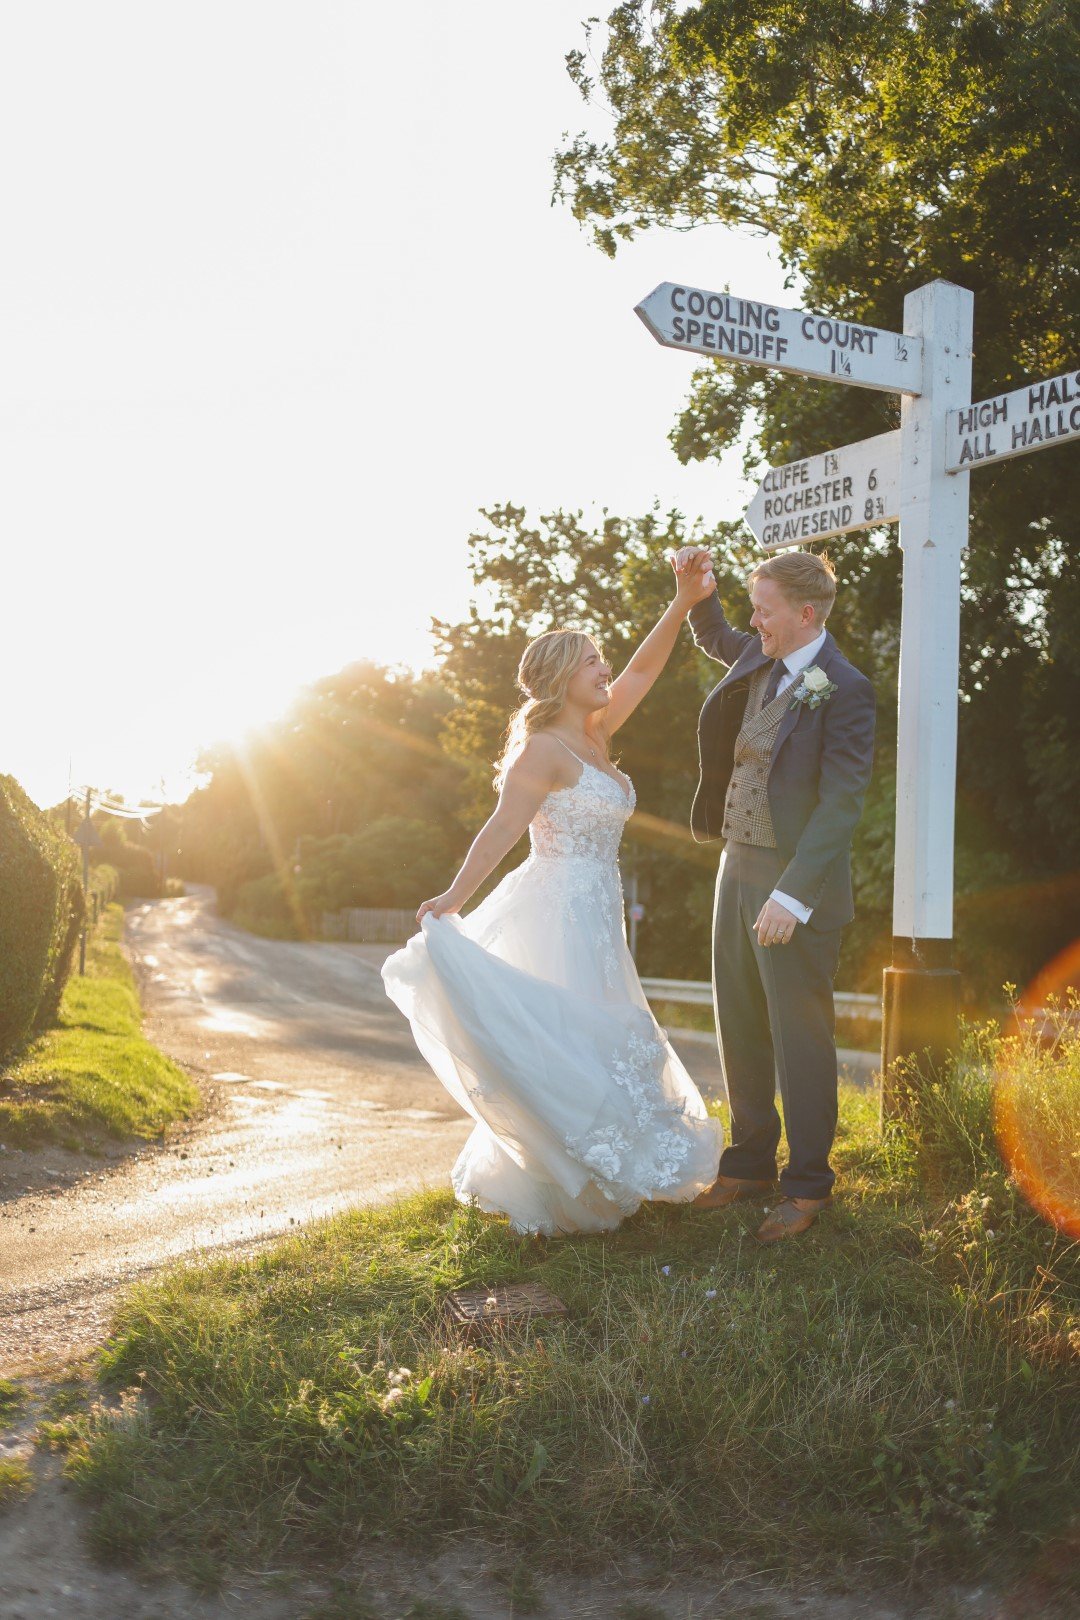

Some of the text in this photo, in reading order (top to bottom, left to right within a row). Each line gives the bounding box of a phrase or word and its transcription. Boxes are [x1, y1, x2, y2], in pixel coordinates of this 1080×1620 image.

[670, 287, 780, 332] COOLING
[801, 316, 877, 354] COURT
[672, 316, 788, 361] SPENDIFF
[959, 397, 1008, 435] HIGH
[959, 433, 996, 465] ALL
[763, 461, 809, 493] CLIFFE
[764, 468, 878, 520] ROCHESTER 6
[762, 504, 852, 545] GRAVESEND
